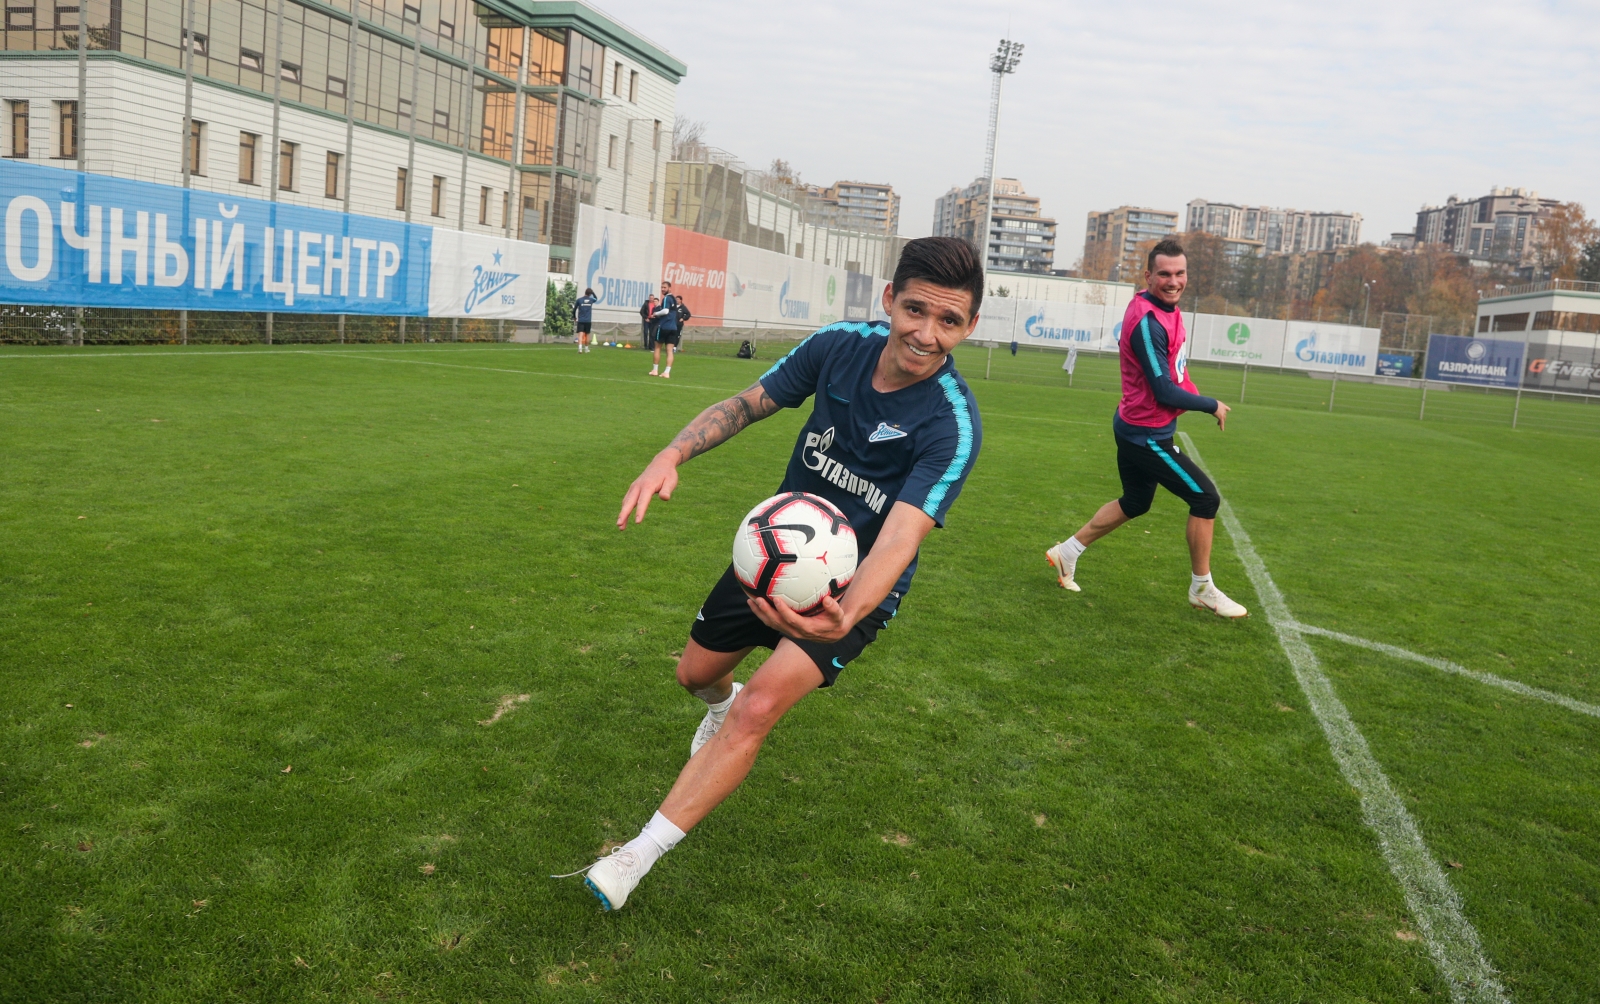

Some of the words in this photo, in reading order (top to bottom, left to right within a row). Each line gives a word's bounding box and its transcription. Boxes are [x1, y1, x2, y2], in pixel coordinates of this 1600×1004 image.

[4, 195, 245, 290] ОЧНЫЙ
[263, 226, 400, 306] ЦЕНТР
[705, 269, 725, 289] 100
[501, 294, 515, 305] 1925
[1043, 326, 1092, 342] ГАЗПРОМ
[1315, 352, 1366, 367] ГАЗПРОМ
[1438, 360, 1507, 377] ГАЗПРОМБАНК
[821, 456, 888, 515] ГАЗПРОМ
